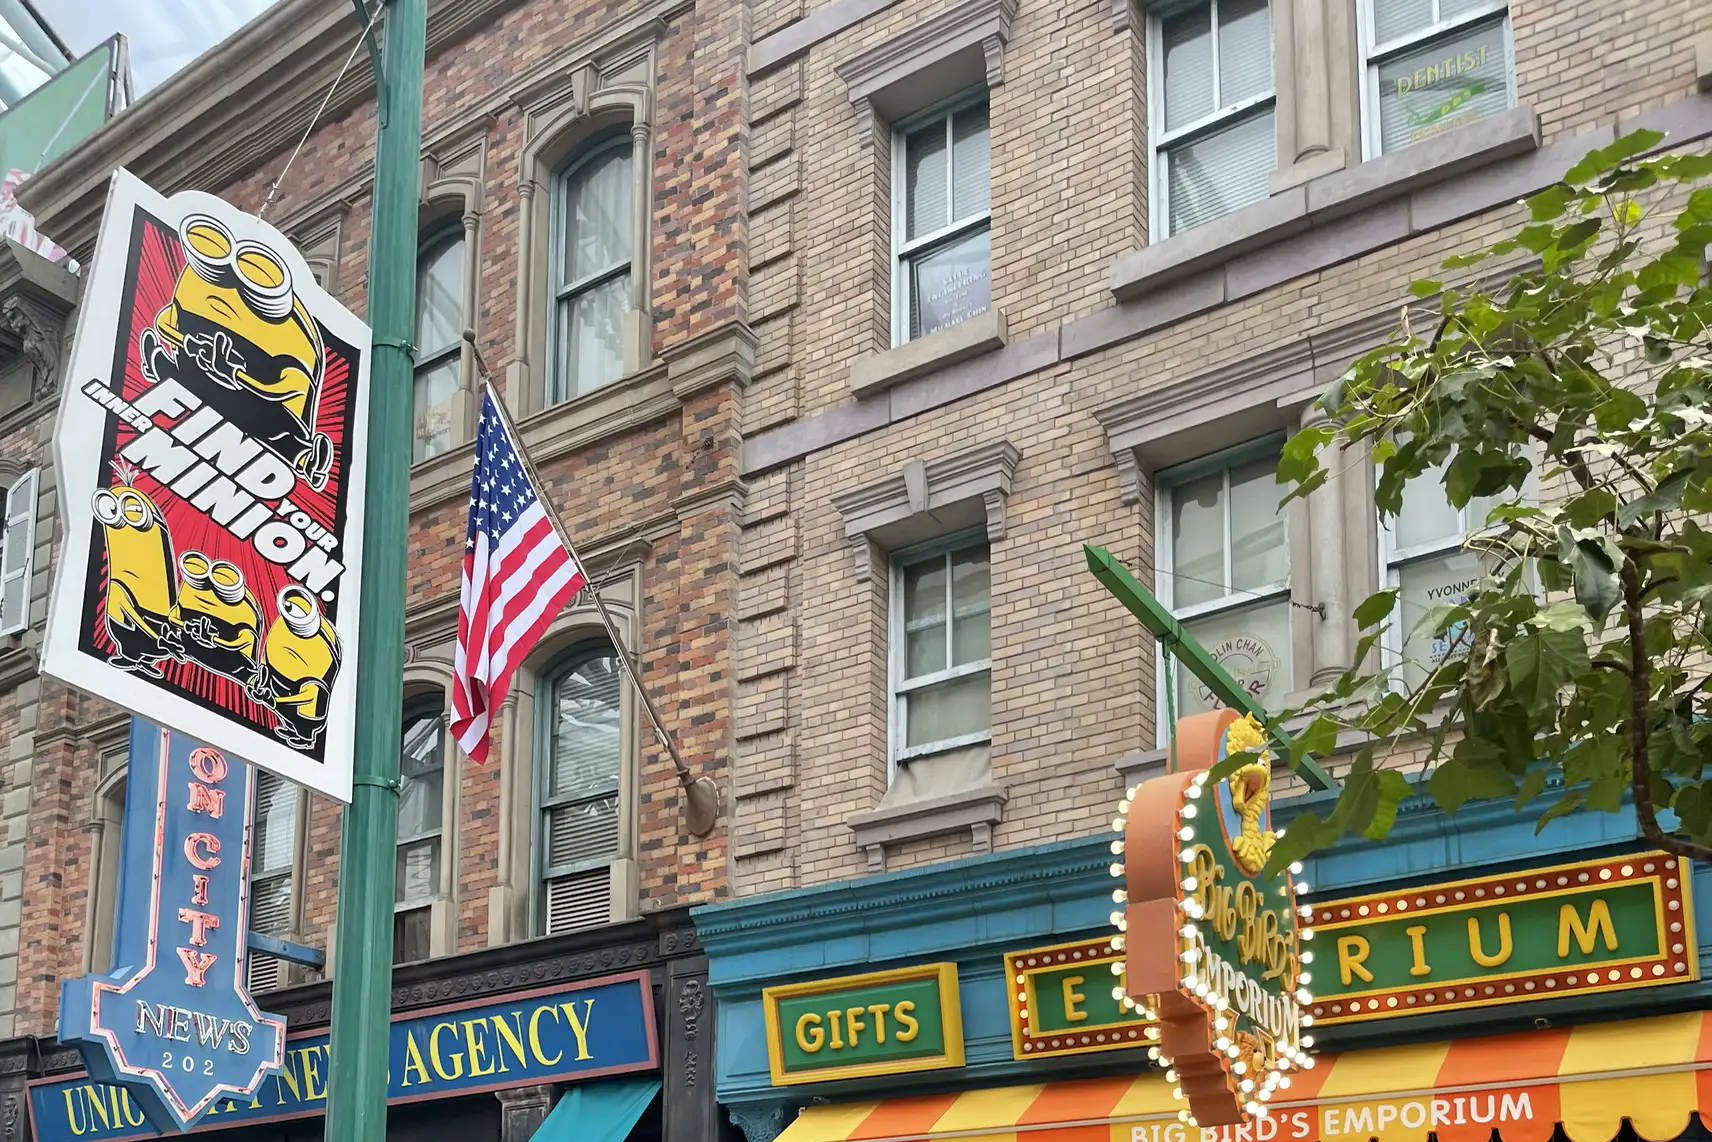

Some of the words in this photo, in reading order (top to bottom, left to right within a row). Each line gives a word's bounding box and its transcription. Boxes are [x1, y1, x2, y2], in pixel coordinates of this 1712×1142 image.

[1396, 44, 1488, 99] DENTIST
[83, 381, 152, 433] INNER
[119, 427, 344, 602] MINION.
[132, 377, 296, 500] FIND
[277, 499, 339, 552] YOUR
[1208, 641, 1242, 662] OLIN
[1246, 639, 1274, 667] CHAN
[176, 832, 222, 987] CITY
[136, 1000, 253, 1055] NEWS
[795, 1001, 919, 1053] GIFTS
[1188, 932, 1301, 1052] EMPORIUM
[401, 998, 596, 1087] AGENCY
[1323, 1092, 1533, 1136] EMPORIUM
